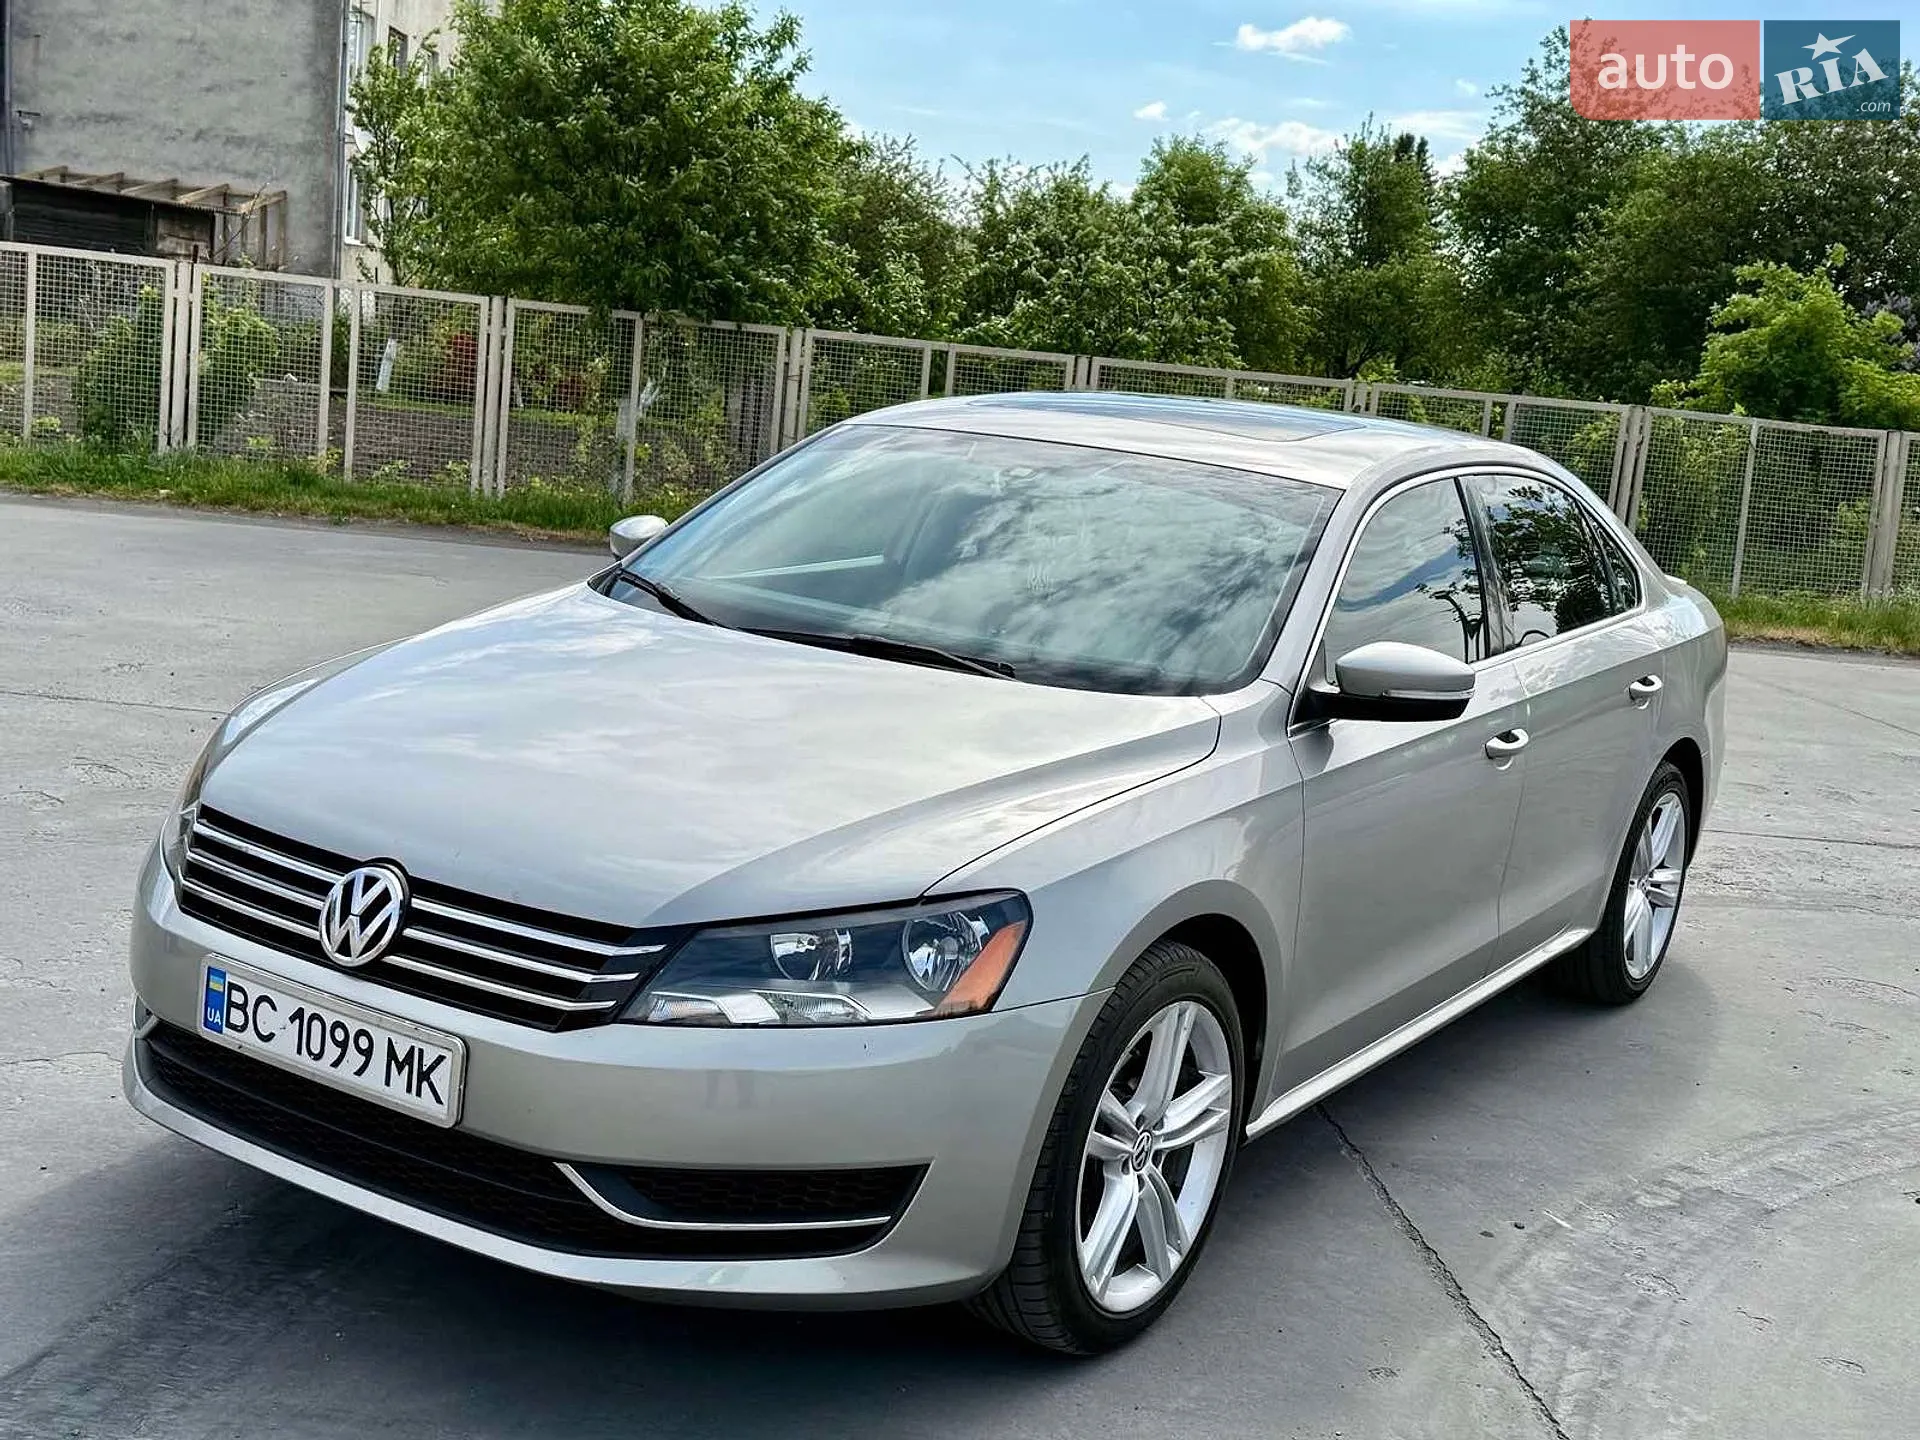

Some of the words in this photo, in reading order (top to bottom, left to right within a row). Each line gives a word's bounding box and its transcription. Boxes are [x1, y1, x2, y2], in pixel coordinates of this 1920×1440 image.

[207, 1008, 222, 1026] UA
[225, 981, 277, 1043] BC
[289, 1006, 375, 1077] 1099
[384, 1037, 447, 1105] MK
